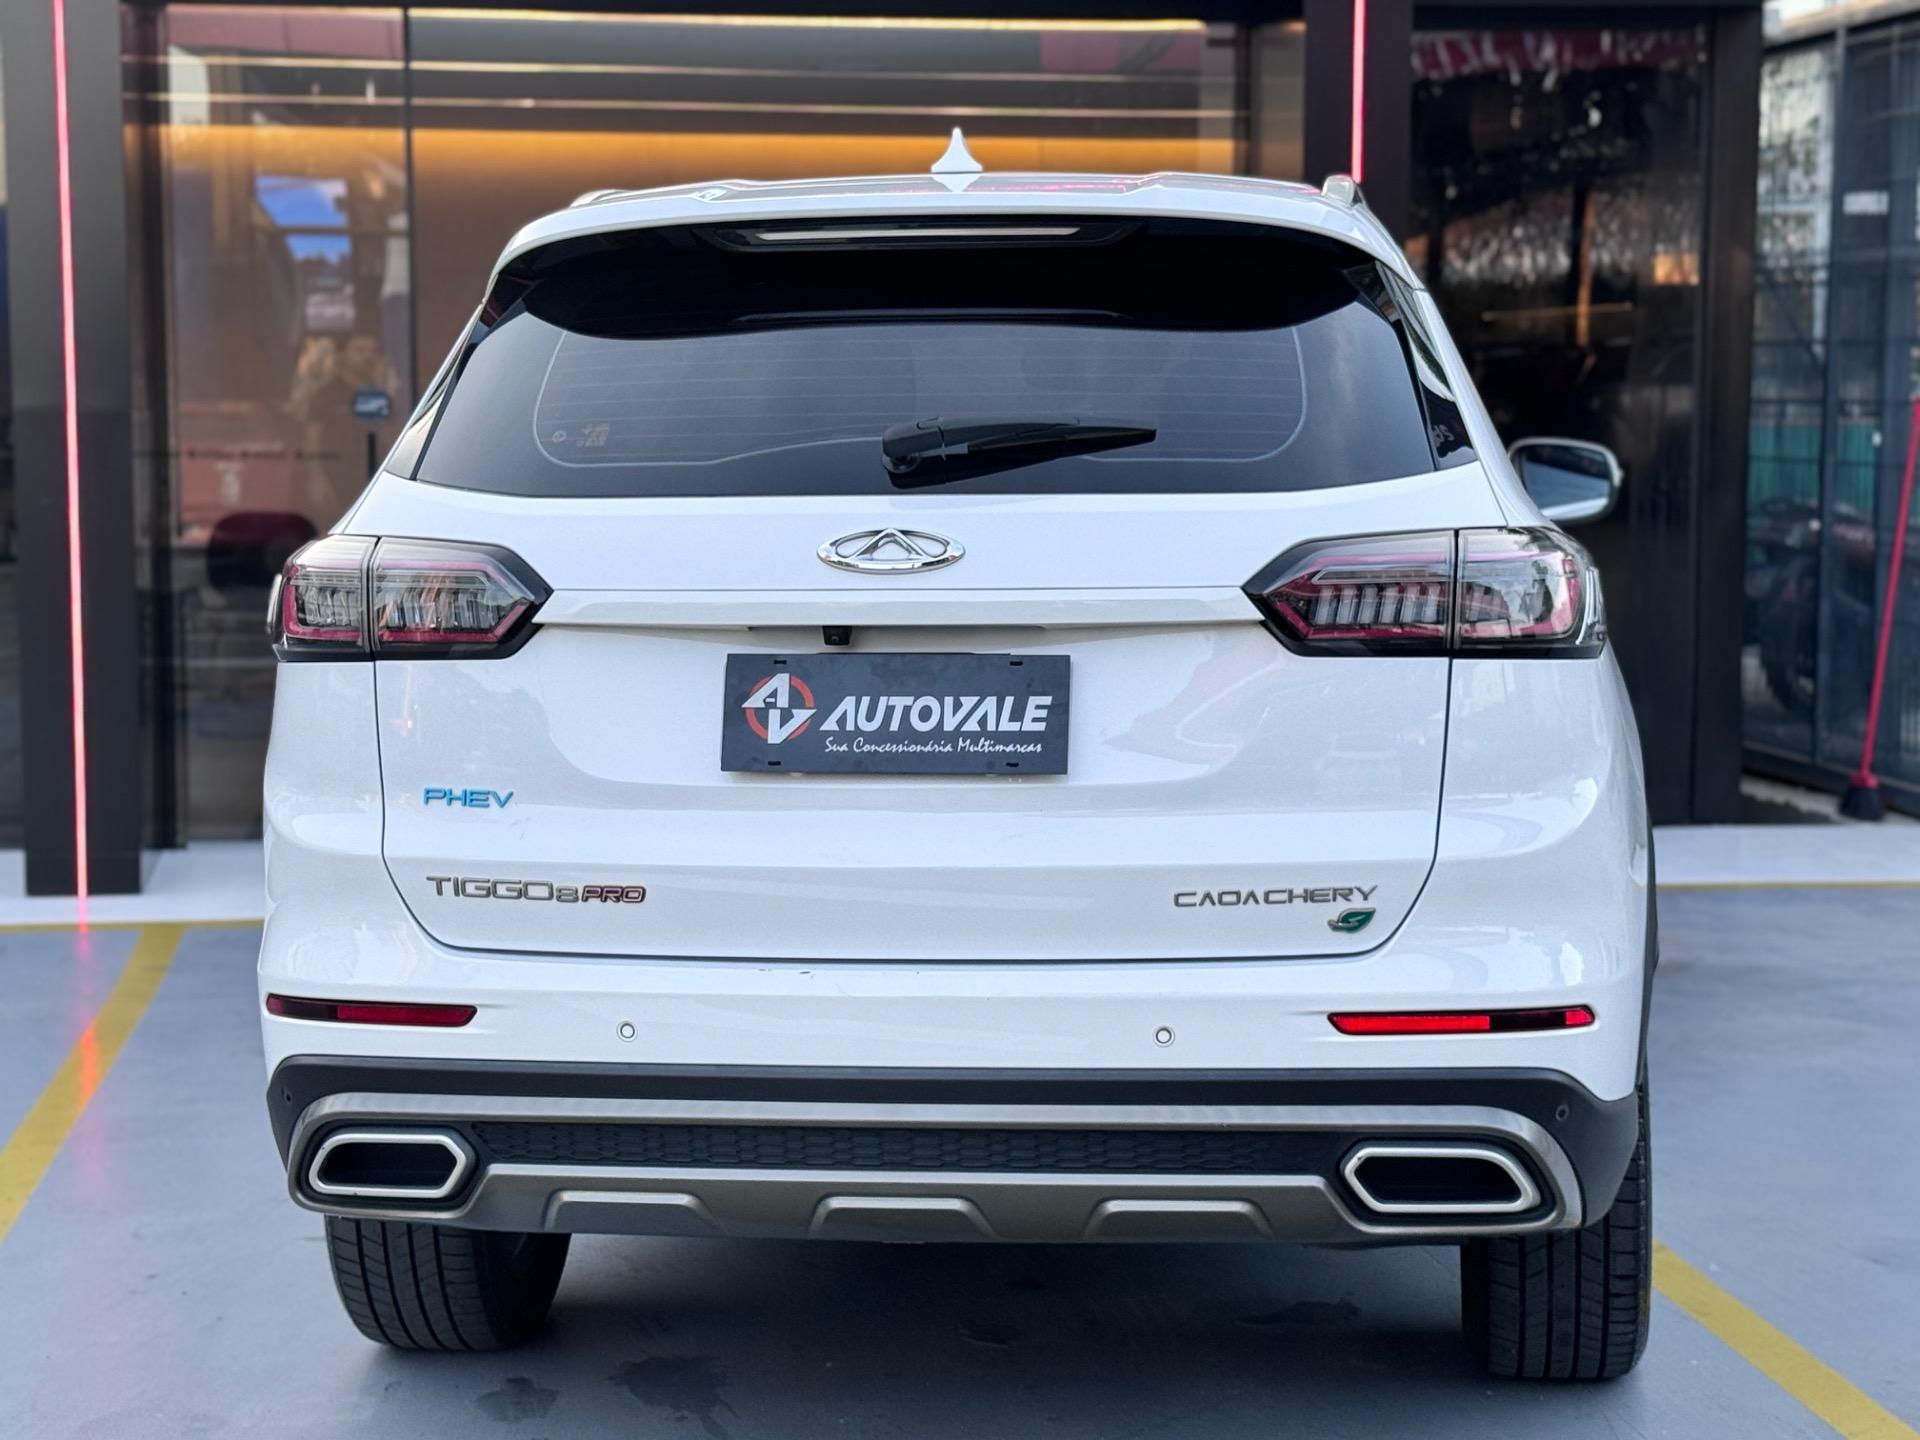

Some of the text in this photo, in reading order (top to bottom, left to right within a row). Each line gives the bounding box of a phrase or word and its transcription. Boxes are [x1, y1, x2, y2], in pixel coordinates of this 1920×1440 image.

[819, 696, 1053, 732] AUTOVALE
[825, 736, 1043, 753] Sua Concessionária Multimarcas
[423, 787, 514, 809] PHEV
